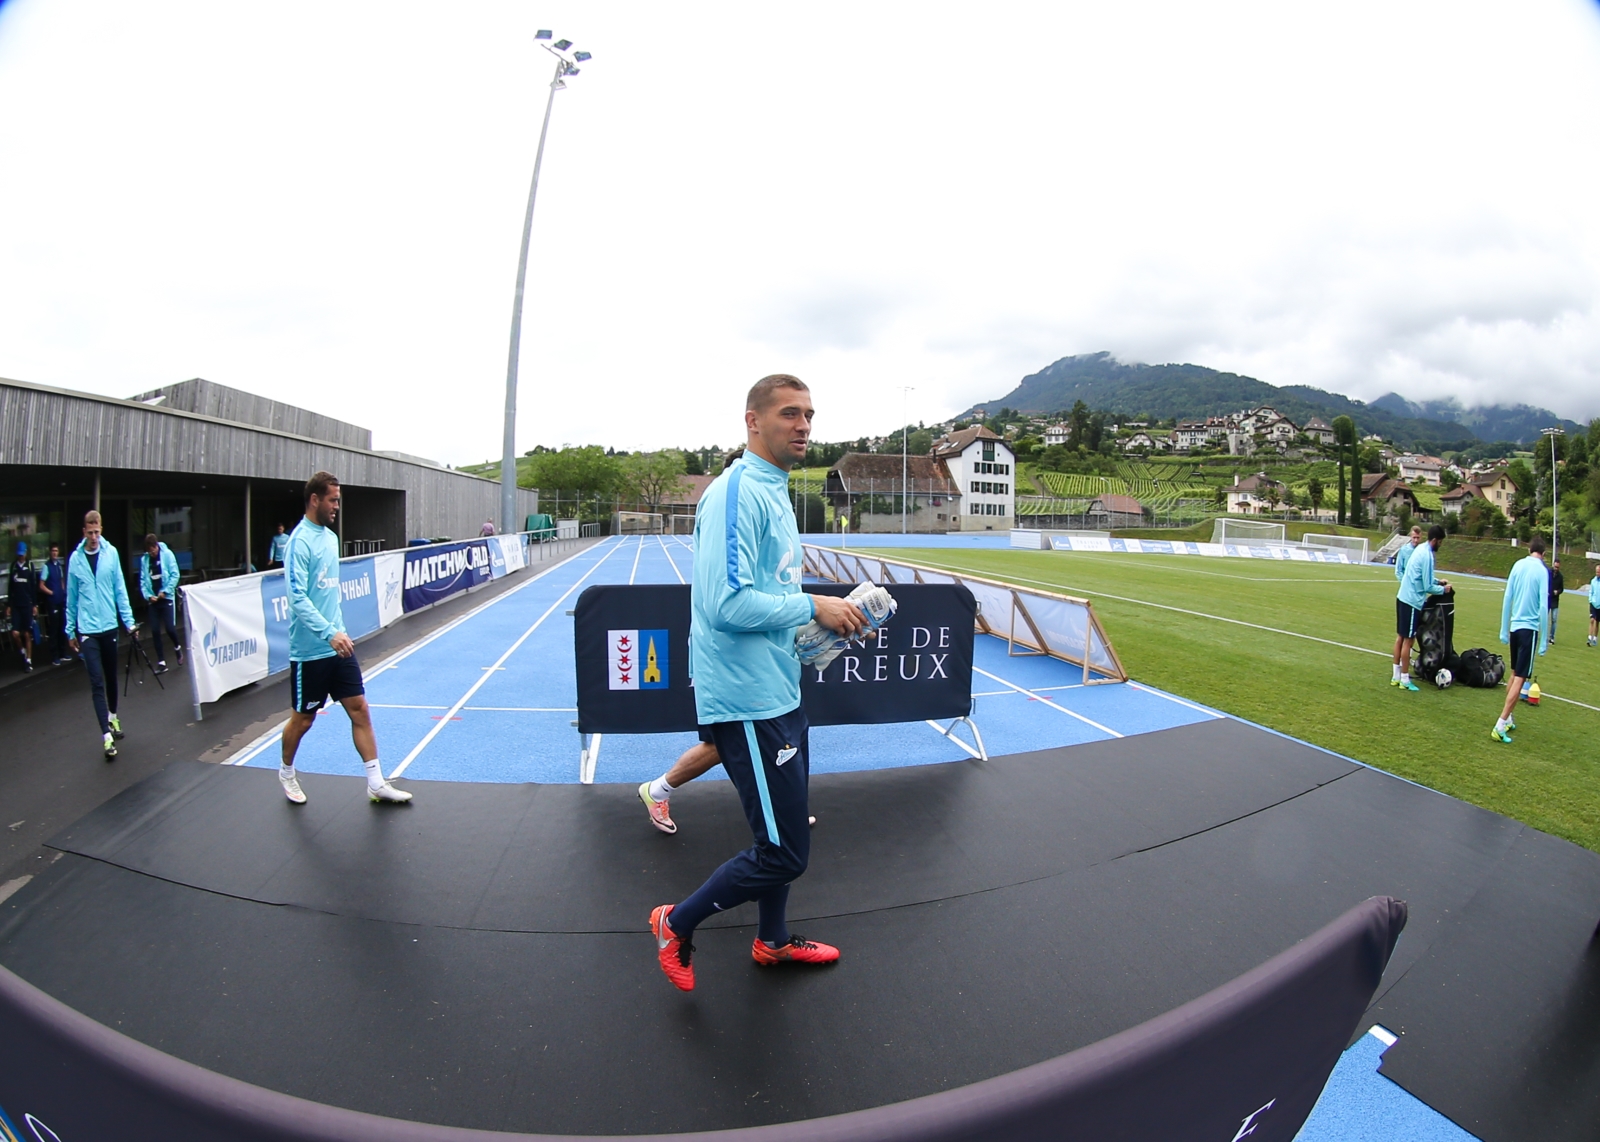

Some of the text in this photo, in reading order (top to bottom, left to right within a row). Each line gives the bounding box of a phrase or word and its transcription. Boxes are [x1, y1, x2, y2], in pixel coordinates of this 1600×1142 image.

[405, 545, 488, 590] MATCHWORLD
[218, 637, 258, 665] ГАЗПРОМ
[911, 626, 950, 650] DE
